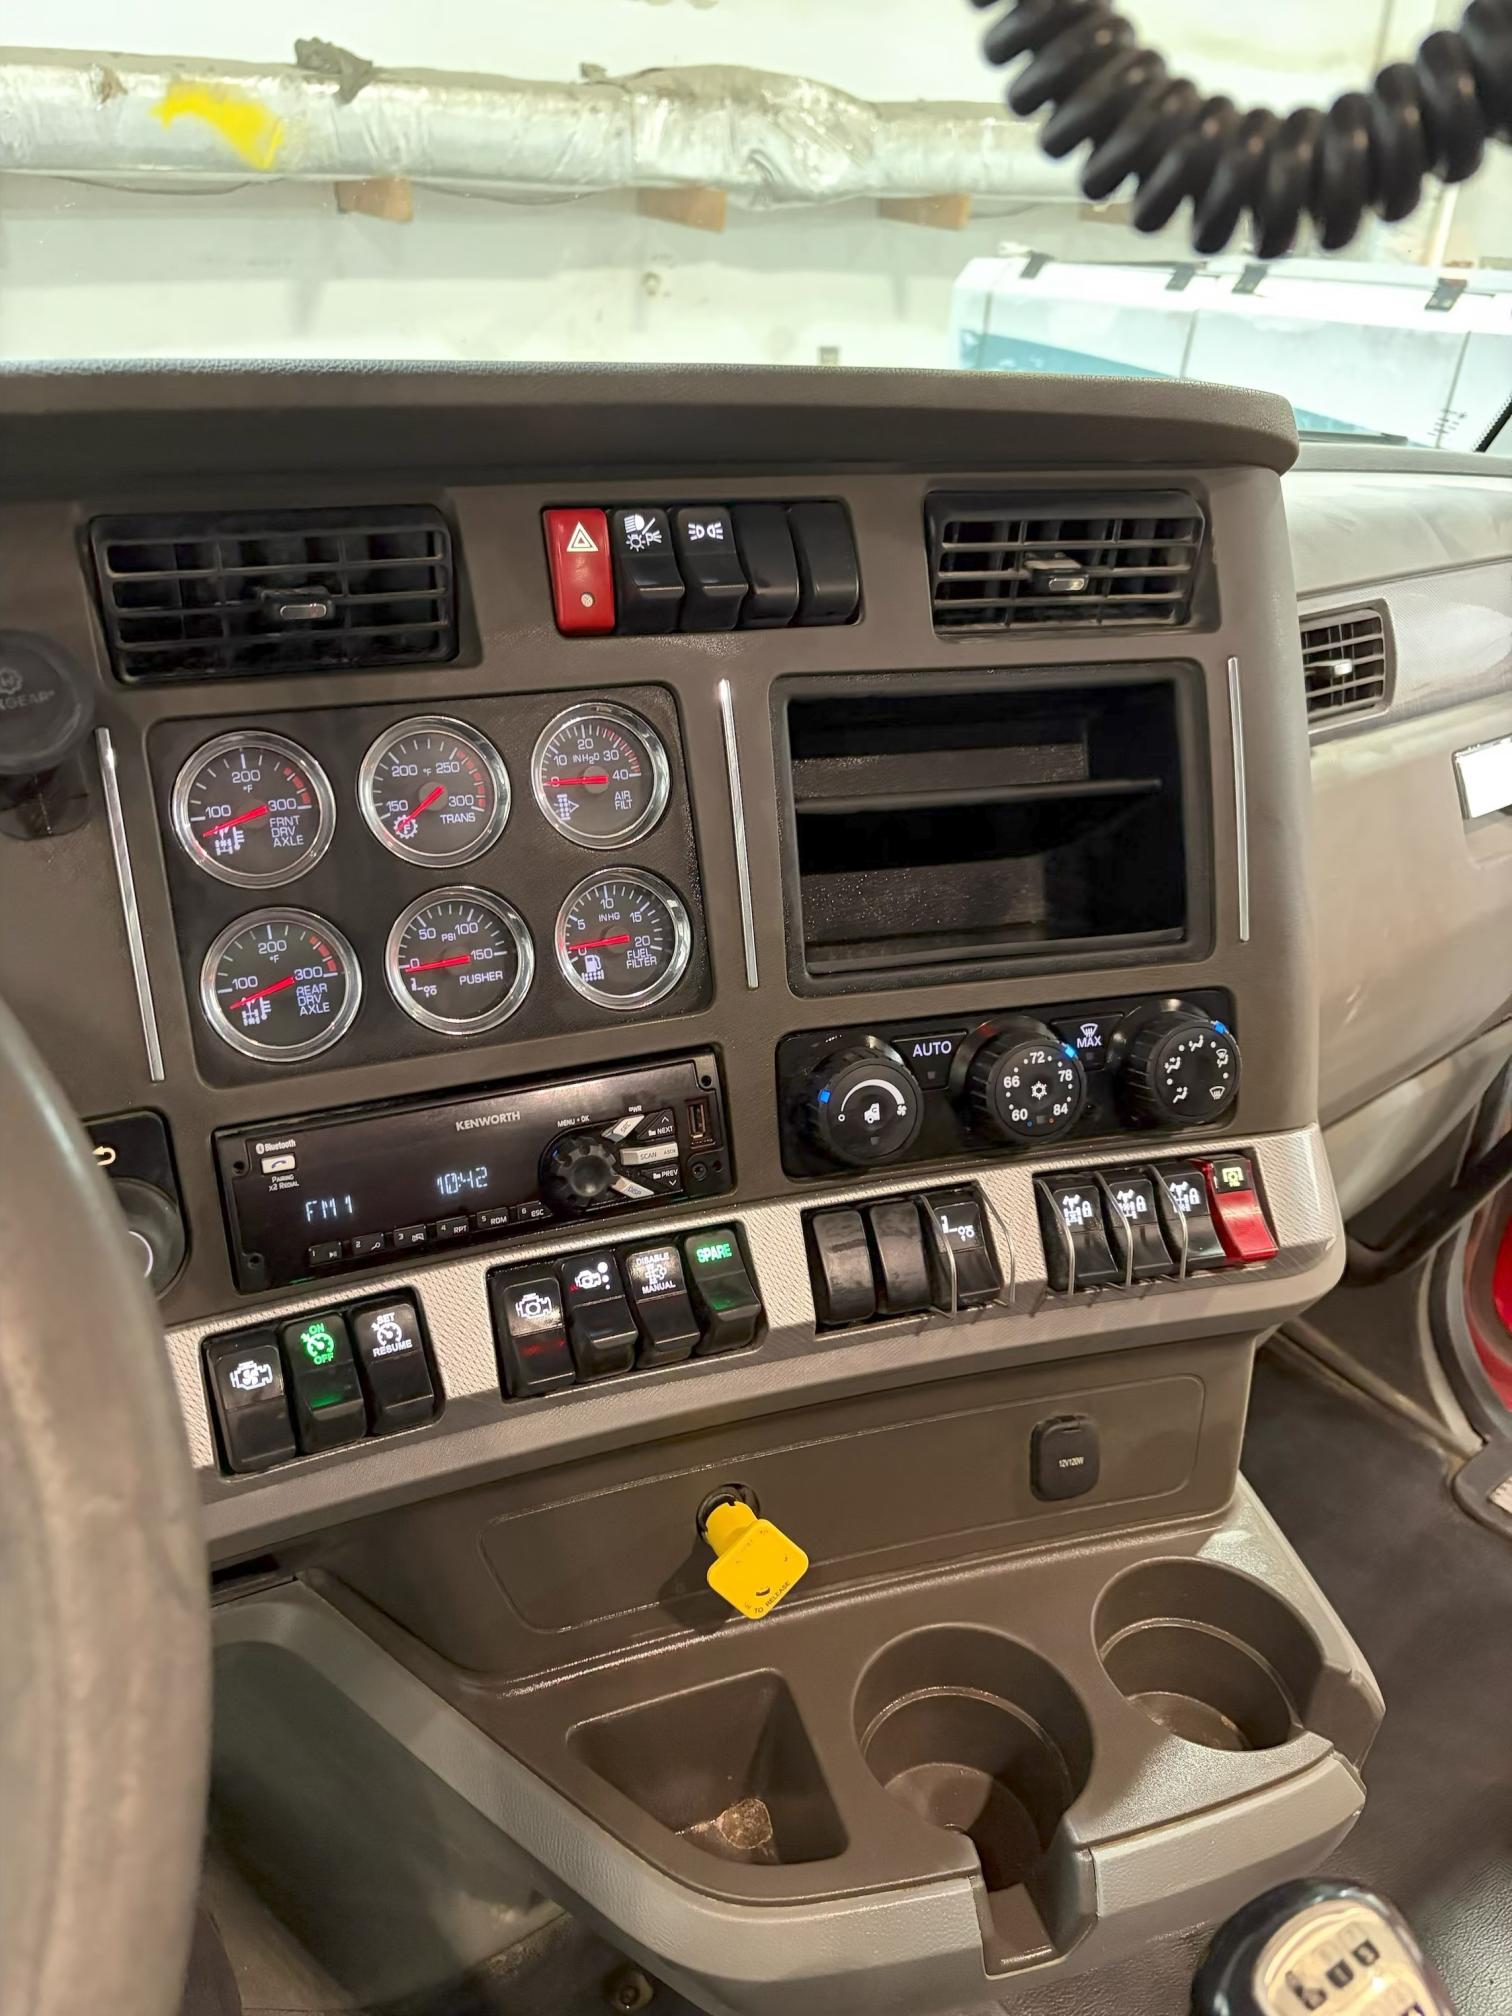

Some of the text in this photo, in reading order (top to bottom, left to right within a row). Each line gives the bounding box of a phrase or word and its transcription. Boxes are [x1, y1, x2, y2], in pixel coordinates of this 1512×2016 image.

[578, 738, 594, 749] 20
[554, 754, 567, 766] 10
[603, 750, 619, 761] 30
[392, 764, 417, 777] 200
[436, 761, 460, 774] 250
[231, 768, 261, 783] 200
[612, 769, 629, 780] 40
[448, 795, 474, 807] 300
[614, 790, 630, 800] AIR
[268, 798, 297, 811] 300
[386, 800, 408, 812] 150
[615, 799, 632, 810] FILT
[205, 804, 232, 819] 100
[440, 812, 475, 824] TRANS
[269, 815, 300, 828] FRNT
[271, 826, 296, 838] DRV
[273, 834, 304, 847] AXLE
[600, 898, 614, 909] 10
[630, 912, 642, 923] 15
[455, 922, 479, 935] 100
[577, 919, 586, 930] 5
[419, 928, 436, 940] 50
[441, 932, 456, 942] PSI
[258, 940, 287, 954] 200
[634, 935, 650, 947] 20
[471, 948, 493, 960] 150
[627, 948, 651, 960] FUEL
[626, 955, 657, 969] FILTER
[294, 966, 323, 981] 300
[459, 970, 503, 986] PUSHER
[232, 976, 258, 989] 100
[296, 983, 328, 997] REAR
[297, 994, 322, 1007] DRV
[300, 1002, 330, 1016] AXLE
[1076, 1035, 1102, 1049] MAX
[912, 1040, 952, 1058] AUTO
[1029, 1051, 1045, 1064] 72
[1058, 1069, 1073, 1082] 78
[1003, 1076, 1020, 1089] 66
[1011, 1109, 1028, 1121] 60
[1053, 1103, 1068, 1115] 84
[456, 1111, 520, 1131] KENWORTH
[557, 1115, 590, 1128] MENU OK
[657, 1126, 673, 1134] NEXT
[264, 1138, 296, 1152] Bluetooth
[661, 1169, 679, 1178] PREV
[436, 1166, 488, 1196] 10:42
[531, 1209, 544, 1218] ESC
[490, 1216, 507, 1225] RDM
[453, 1224, 467, 1234] RPT
[636, 1252, 670, 1266] DISABLE
[696, 1243, 733, 1263] SPARE
[641, 1280, 676, 1295] MANUAL
[376, 1312, 395, 1324] SET
[308, 1323, 325, 1334] ON
[372, 1339, 413, 1357] RESUME
[313, 1351, 334, 1365] OFF
